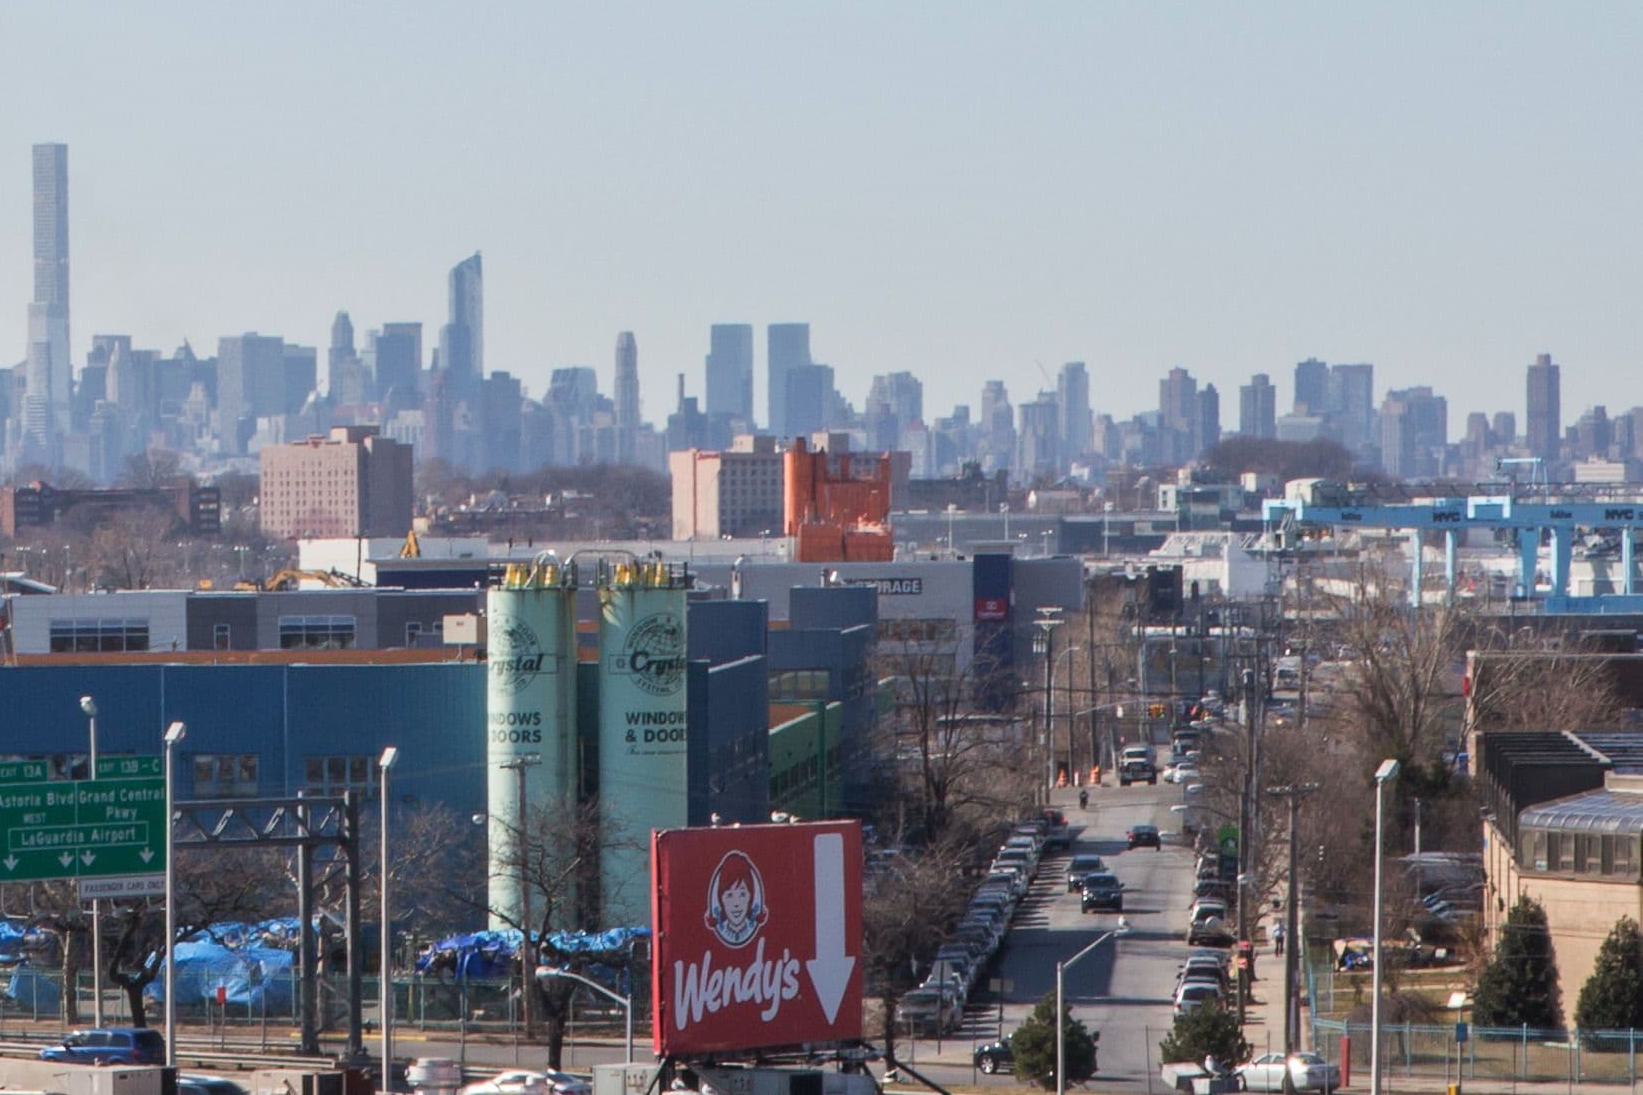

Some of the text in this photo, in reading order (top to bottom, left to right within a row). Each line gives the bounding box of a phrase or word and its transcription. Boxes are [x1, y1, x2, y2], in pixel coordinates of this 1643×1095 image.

[625, 730, 637, 743] &
[1, 766, 43, 778] EXIT 13A
[99, 763, 115, 774] EXIT
[47, 790, 75, 806] Blvd
[79, 787, 165, 804] Grand Central
[23, 812, 47, 824] WEST
[106, 806, 138, 822] Pkwy
[21, 827, 136, 846] LaGuardia Airport
[674, 936, 801, 1031] Wendy's
